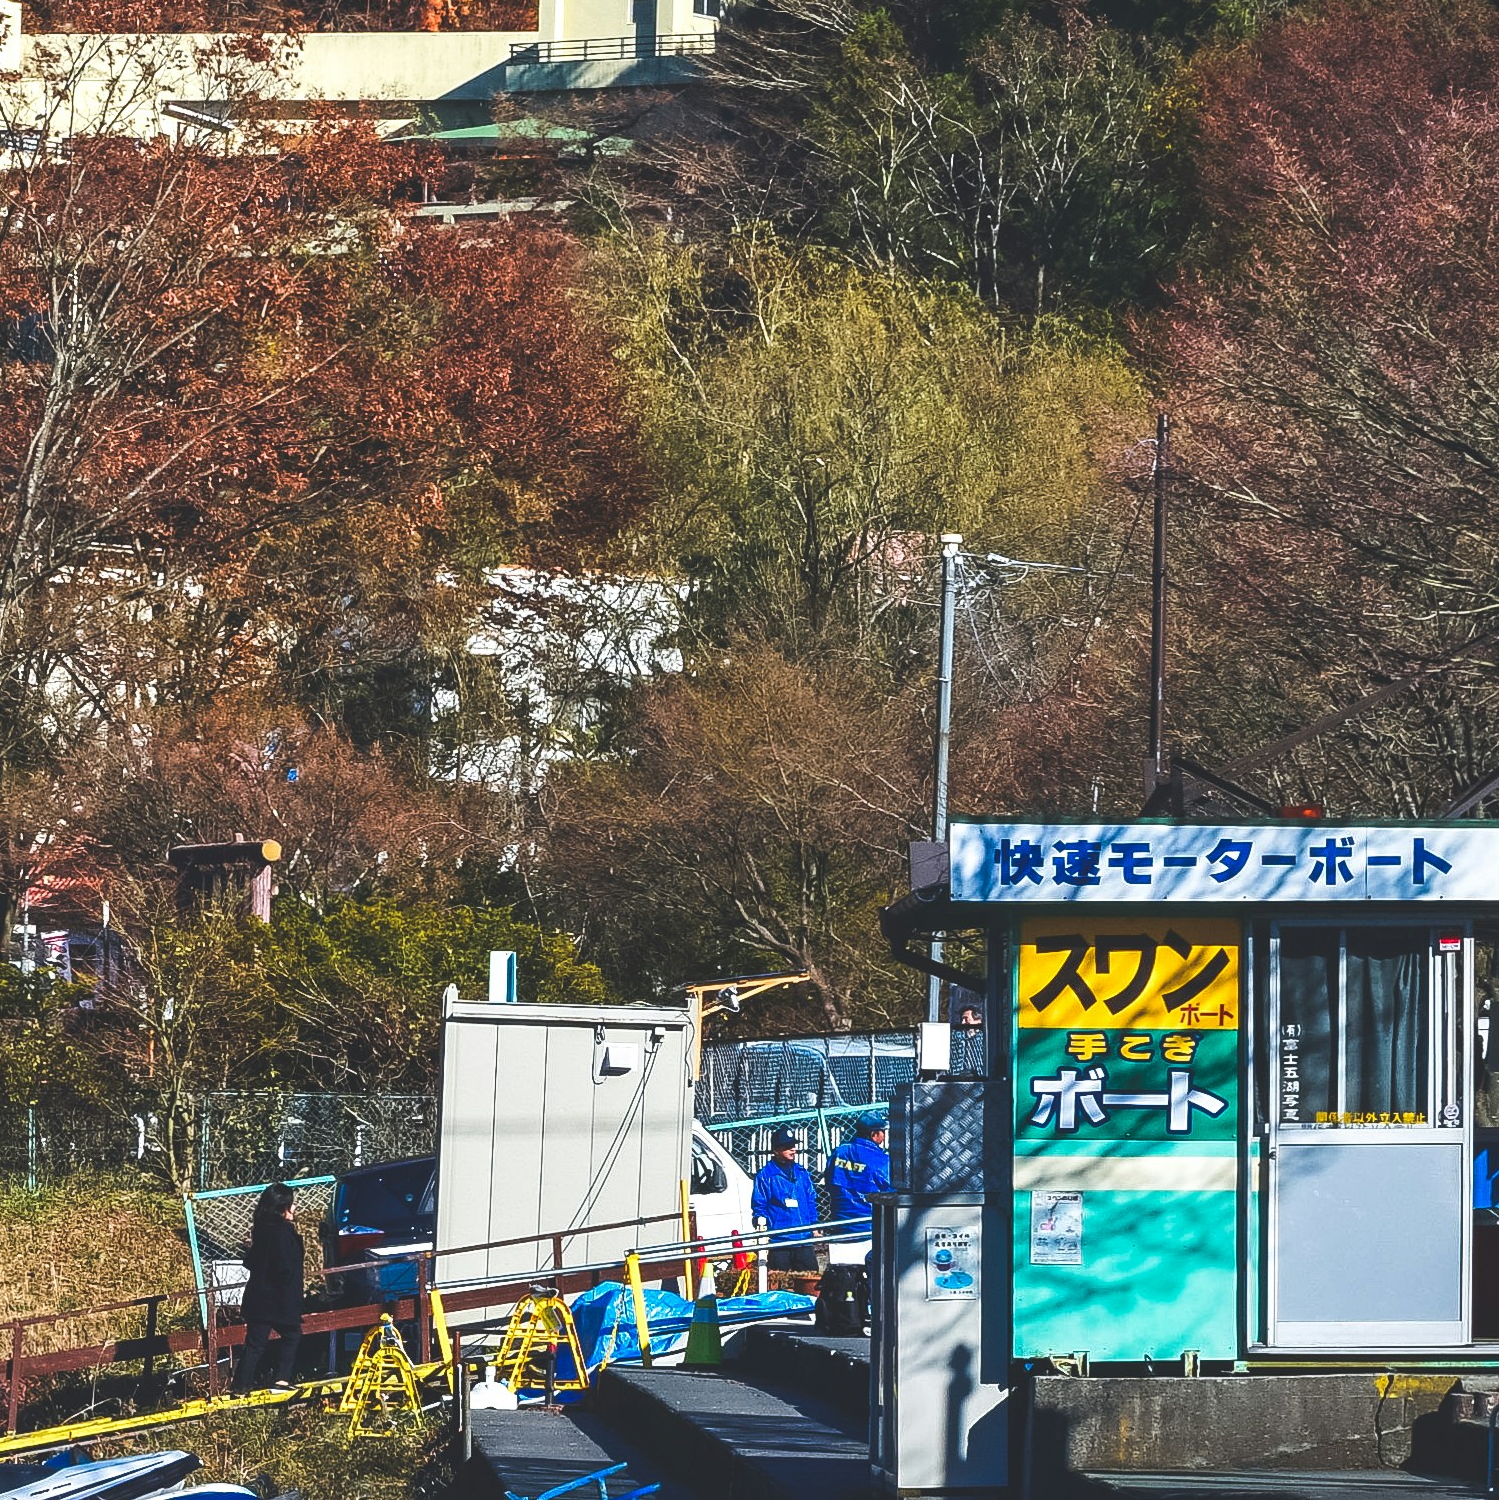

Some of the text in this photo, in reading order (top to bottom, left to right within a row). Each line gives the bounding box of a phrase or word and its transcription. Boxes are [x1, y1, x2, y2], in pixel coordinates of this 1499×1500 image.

[995, 837, 1453, 885] 快速モーターボート
[1029, 928, 1230, 1015] スワン
[1180, 1002, 1234, 1026] ボート
[1029, 1069, 1226, 1132] ボート
